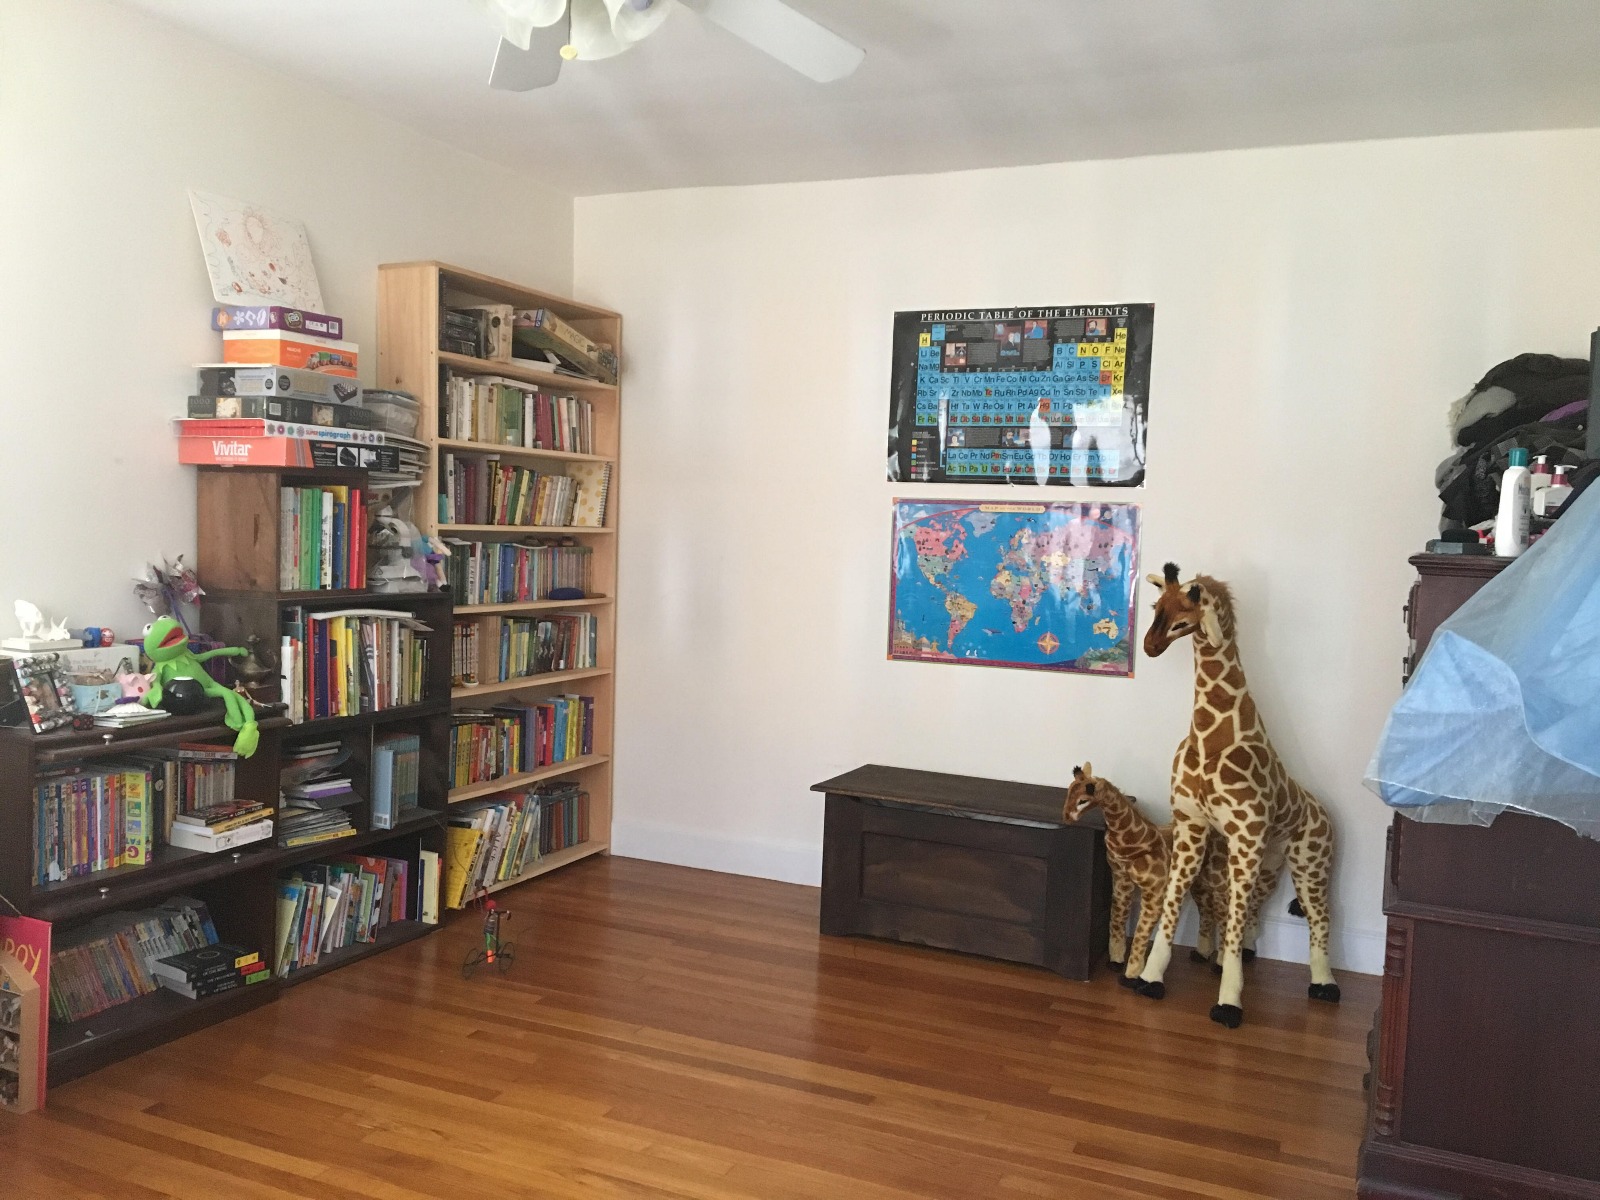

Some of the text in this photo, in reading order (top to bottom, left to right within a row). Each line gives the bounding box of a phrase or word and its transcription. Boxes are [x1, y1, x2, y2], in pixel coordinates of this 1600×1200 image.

[920, 307, 1129, 321] PERIODIC TABLE OF THE ELEMENTS
[318, 428, 351, 440] spirograph
[212, 440, 252, 456] Vivitar
